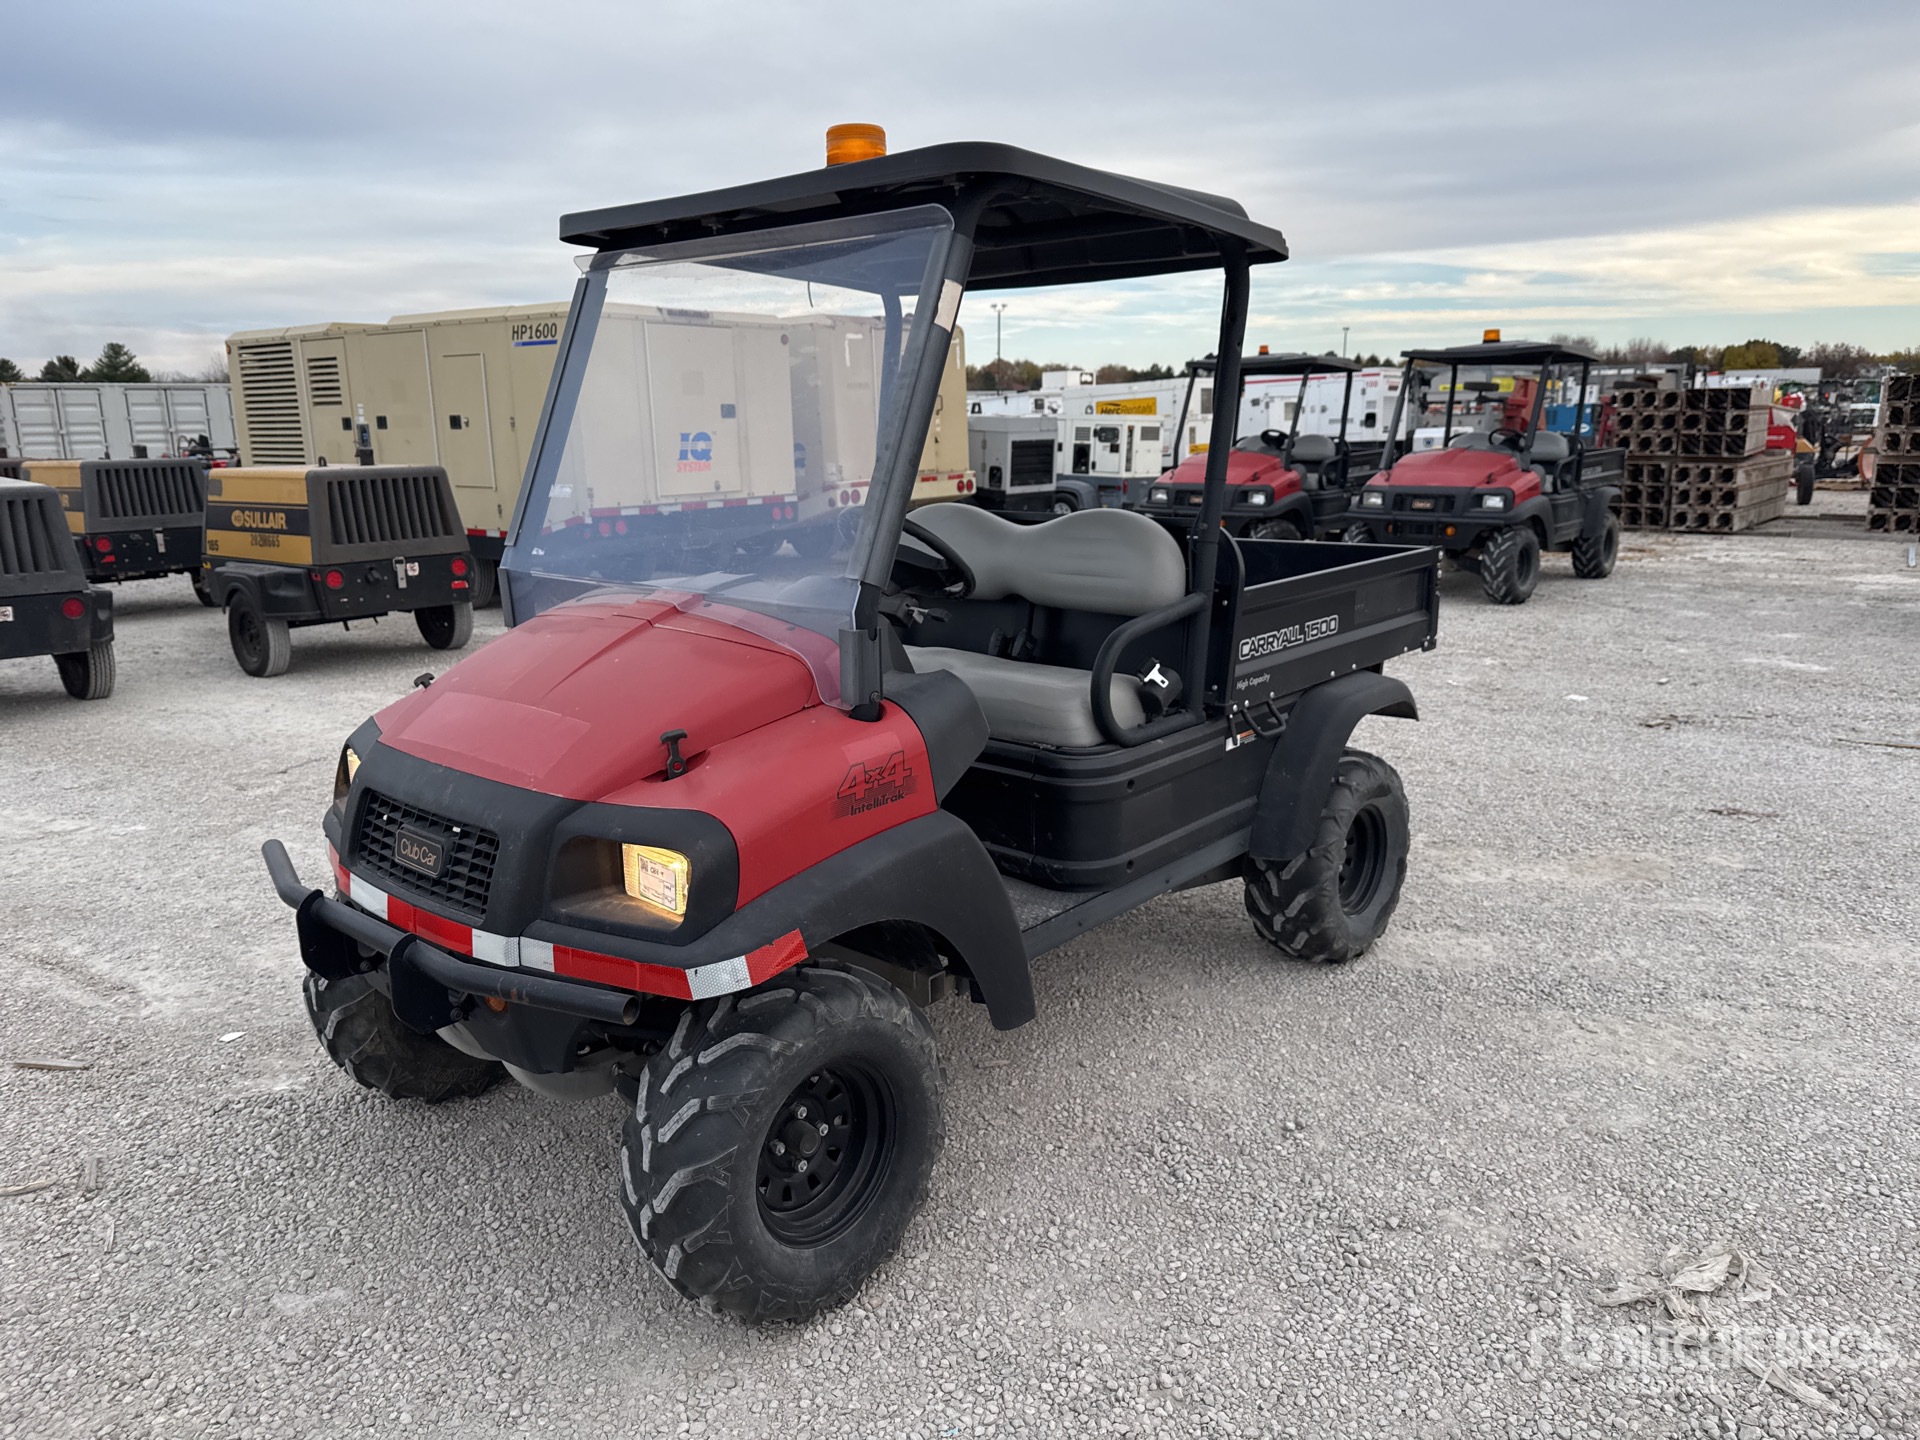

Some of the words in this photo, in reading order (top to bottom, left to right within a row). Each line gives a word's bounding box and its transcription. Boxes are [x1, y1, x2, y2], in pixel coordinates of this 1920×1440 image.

[512, 322, 557, 340] HP1600
[677, 431, 713, 461] IQ
[676, 461, 712, 473] SYSTEM
[243, 510, 287, 529] SULLAIR
[1239, 625, 1304, 660] CARRYALL
[1305, 614, 1339, 641] 1500
[1236, 678, 1248, 691] High
[1249, 673, 1271, 686] Capacity
[837, 750, 913, 802] 4x4
